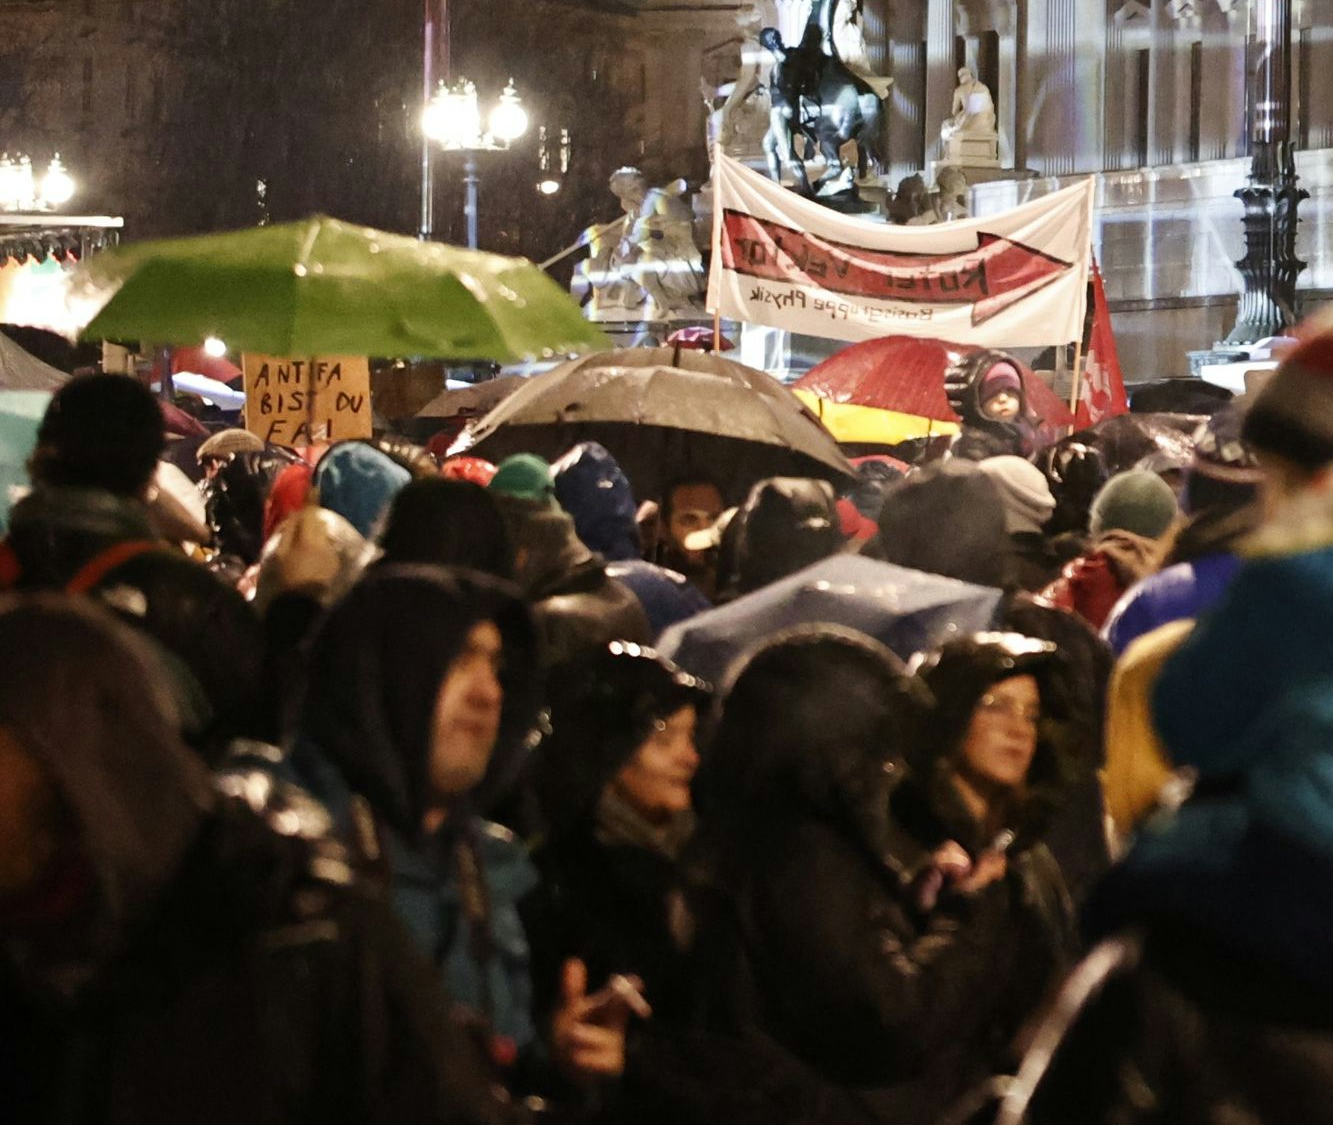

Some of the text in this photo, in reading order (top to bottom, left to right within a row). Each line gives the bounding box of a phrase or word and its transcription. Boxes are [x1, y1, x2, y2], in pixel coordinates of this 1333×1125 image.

[254, 361, 341, 389] ANTIFA
[261, 390, 364, 415] BIST DU
